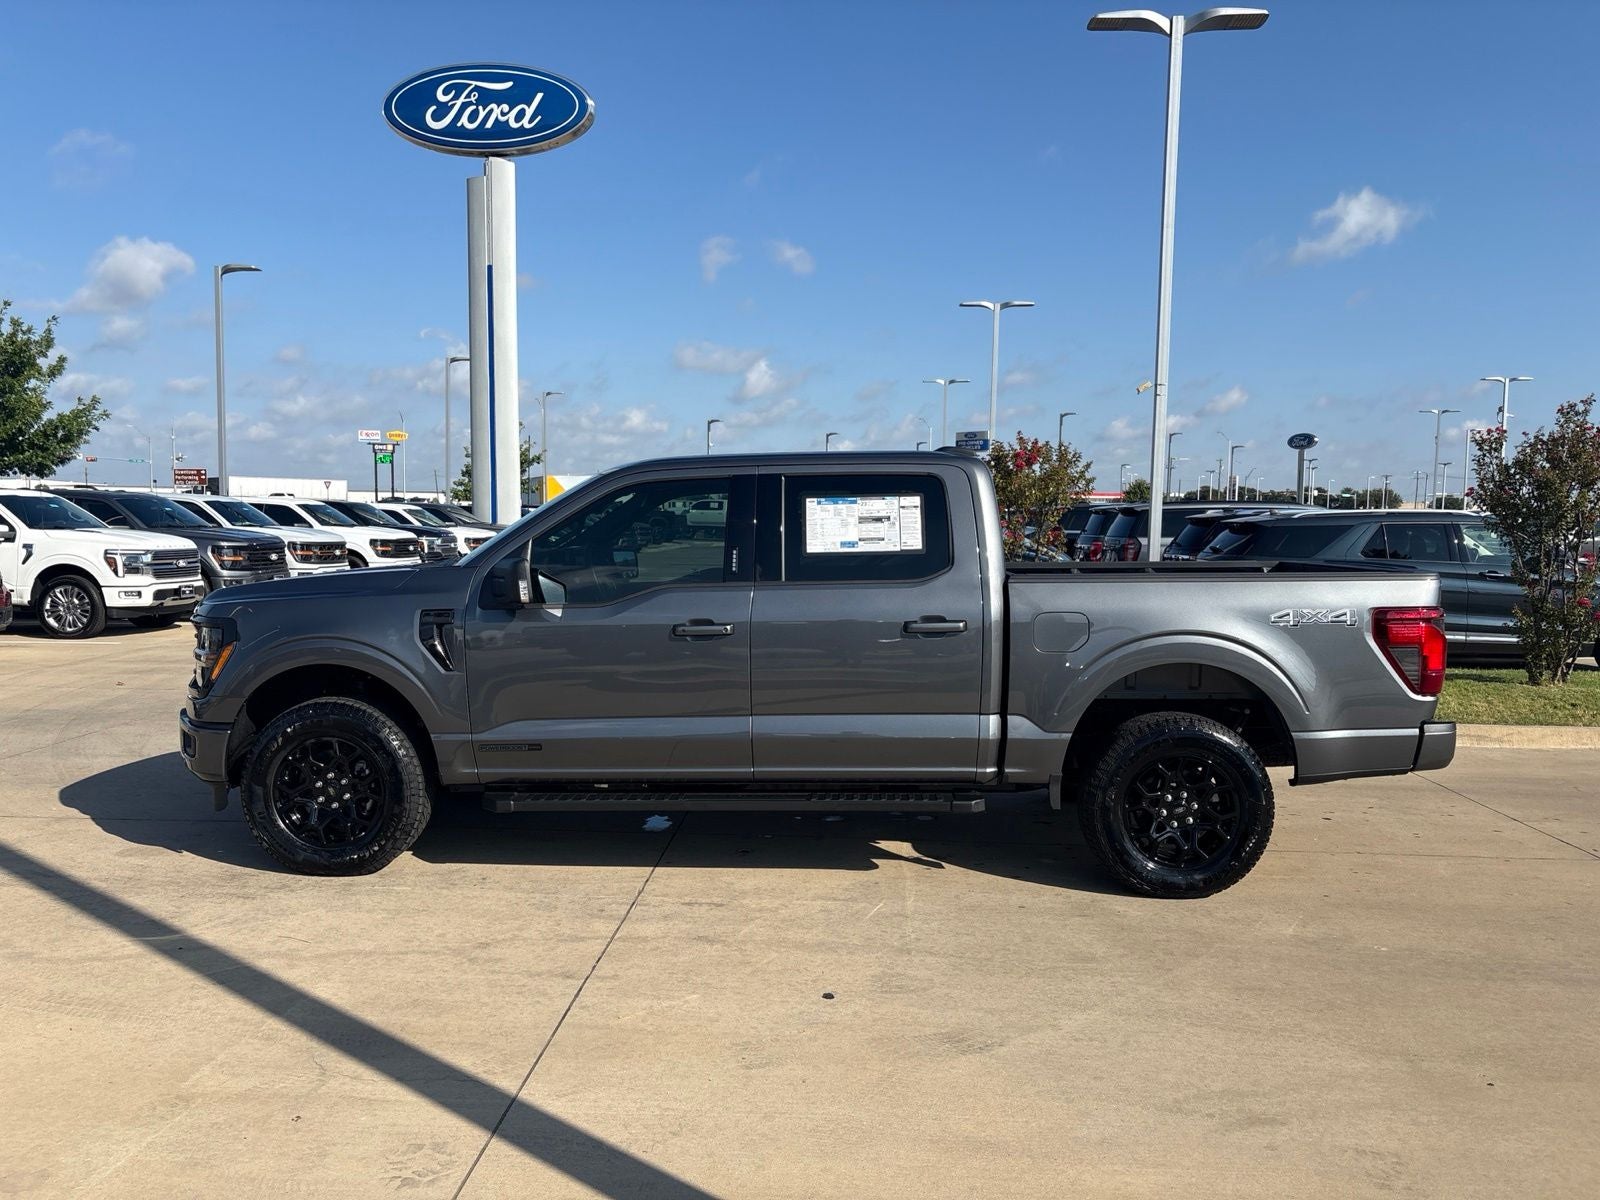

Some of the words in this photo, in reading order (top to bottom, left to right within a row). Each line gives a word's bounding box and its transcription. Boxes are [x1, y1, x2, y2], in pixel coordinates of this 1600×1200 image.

[425, 79, 544, 130] Ford
[360, 431, 380, 439] Exxon
[1270, 608, 1358, 628] 4X4
